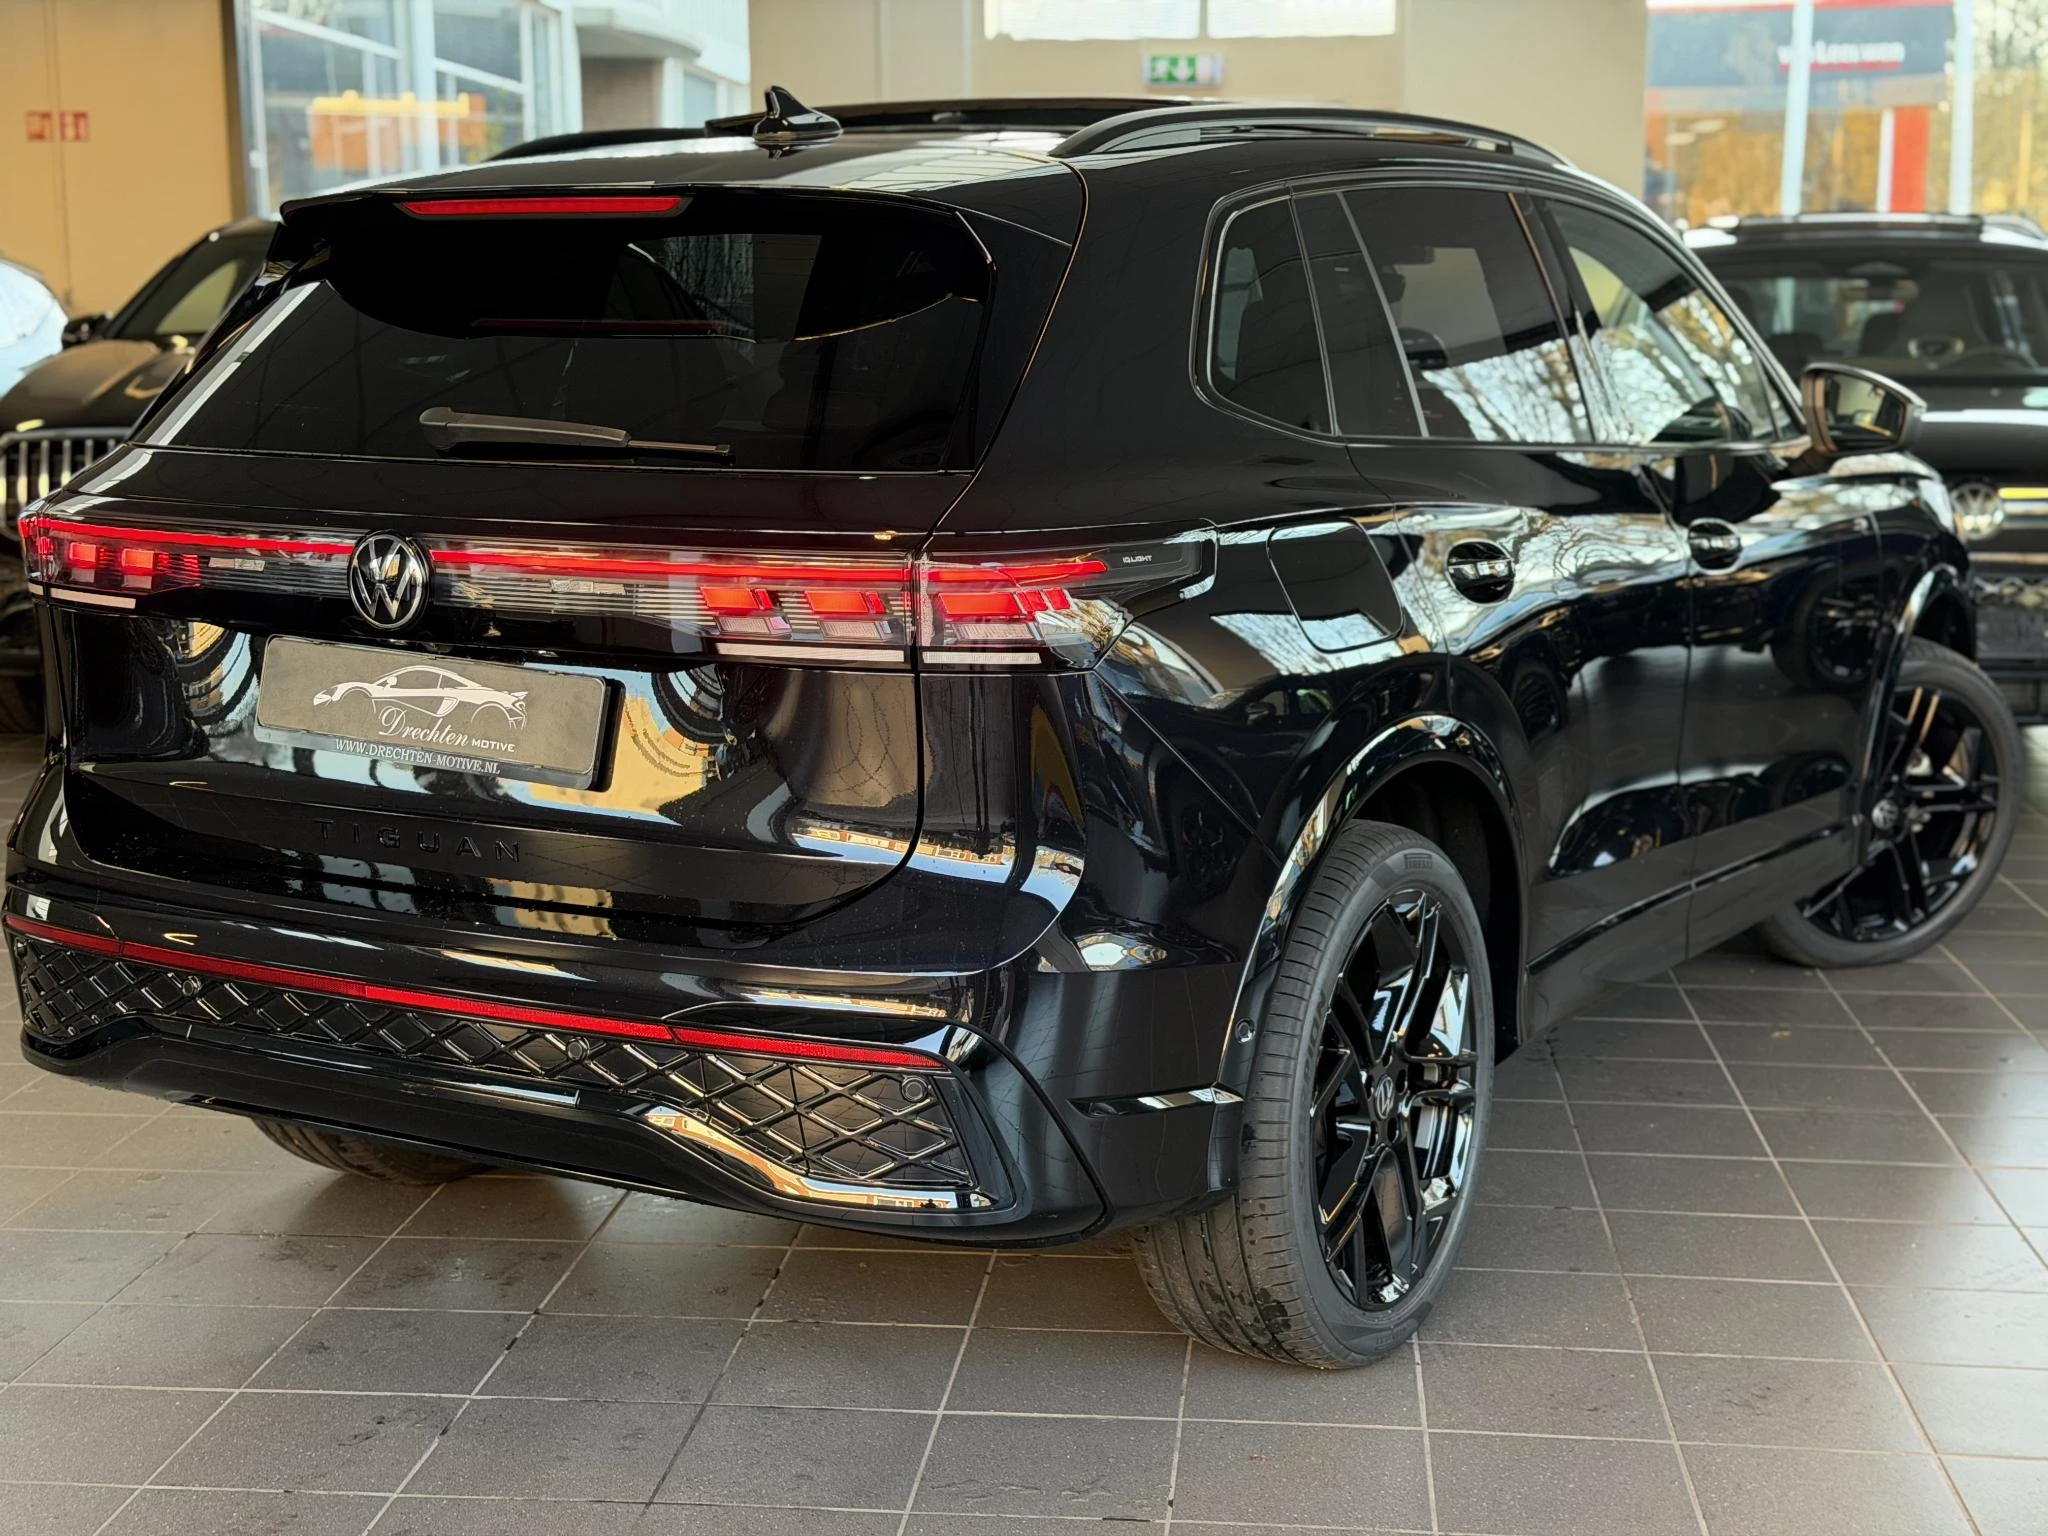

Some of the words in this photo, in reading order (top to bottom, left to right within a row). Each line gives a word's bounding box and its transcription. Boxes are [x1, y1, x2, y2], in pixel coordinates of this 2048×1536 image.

[378, 706, 469, 747] Drechten
[471, 737, 516, 753] MOTIVE
[336, 738, 501, 775] WWW.DRECHTEN-MOTIVE.NL
[313, 817, 521, 863] TIGUAN
